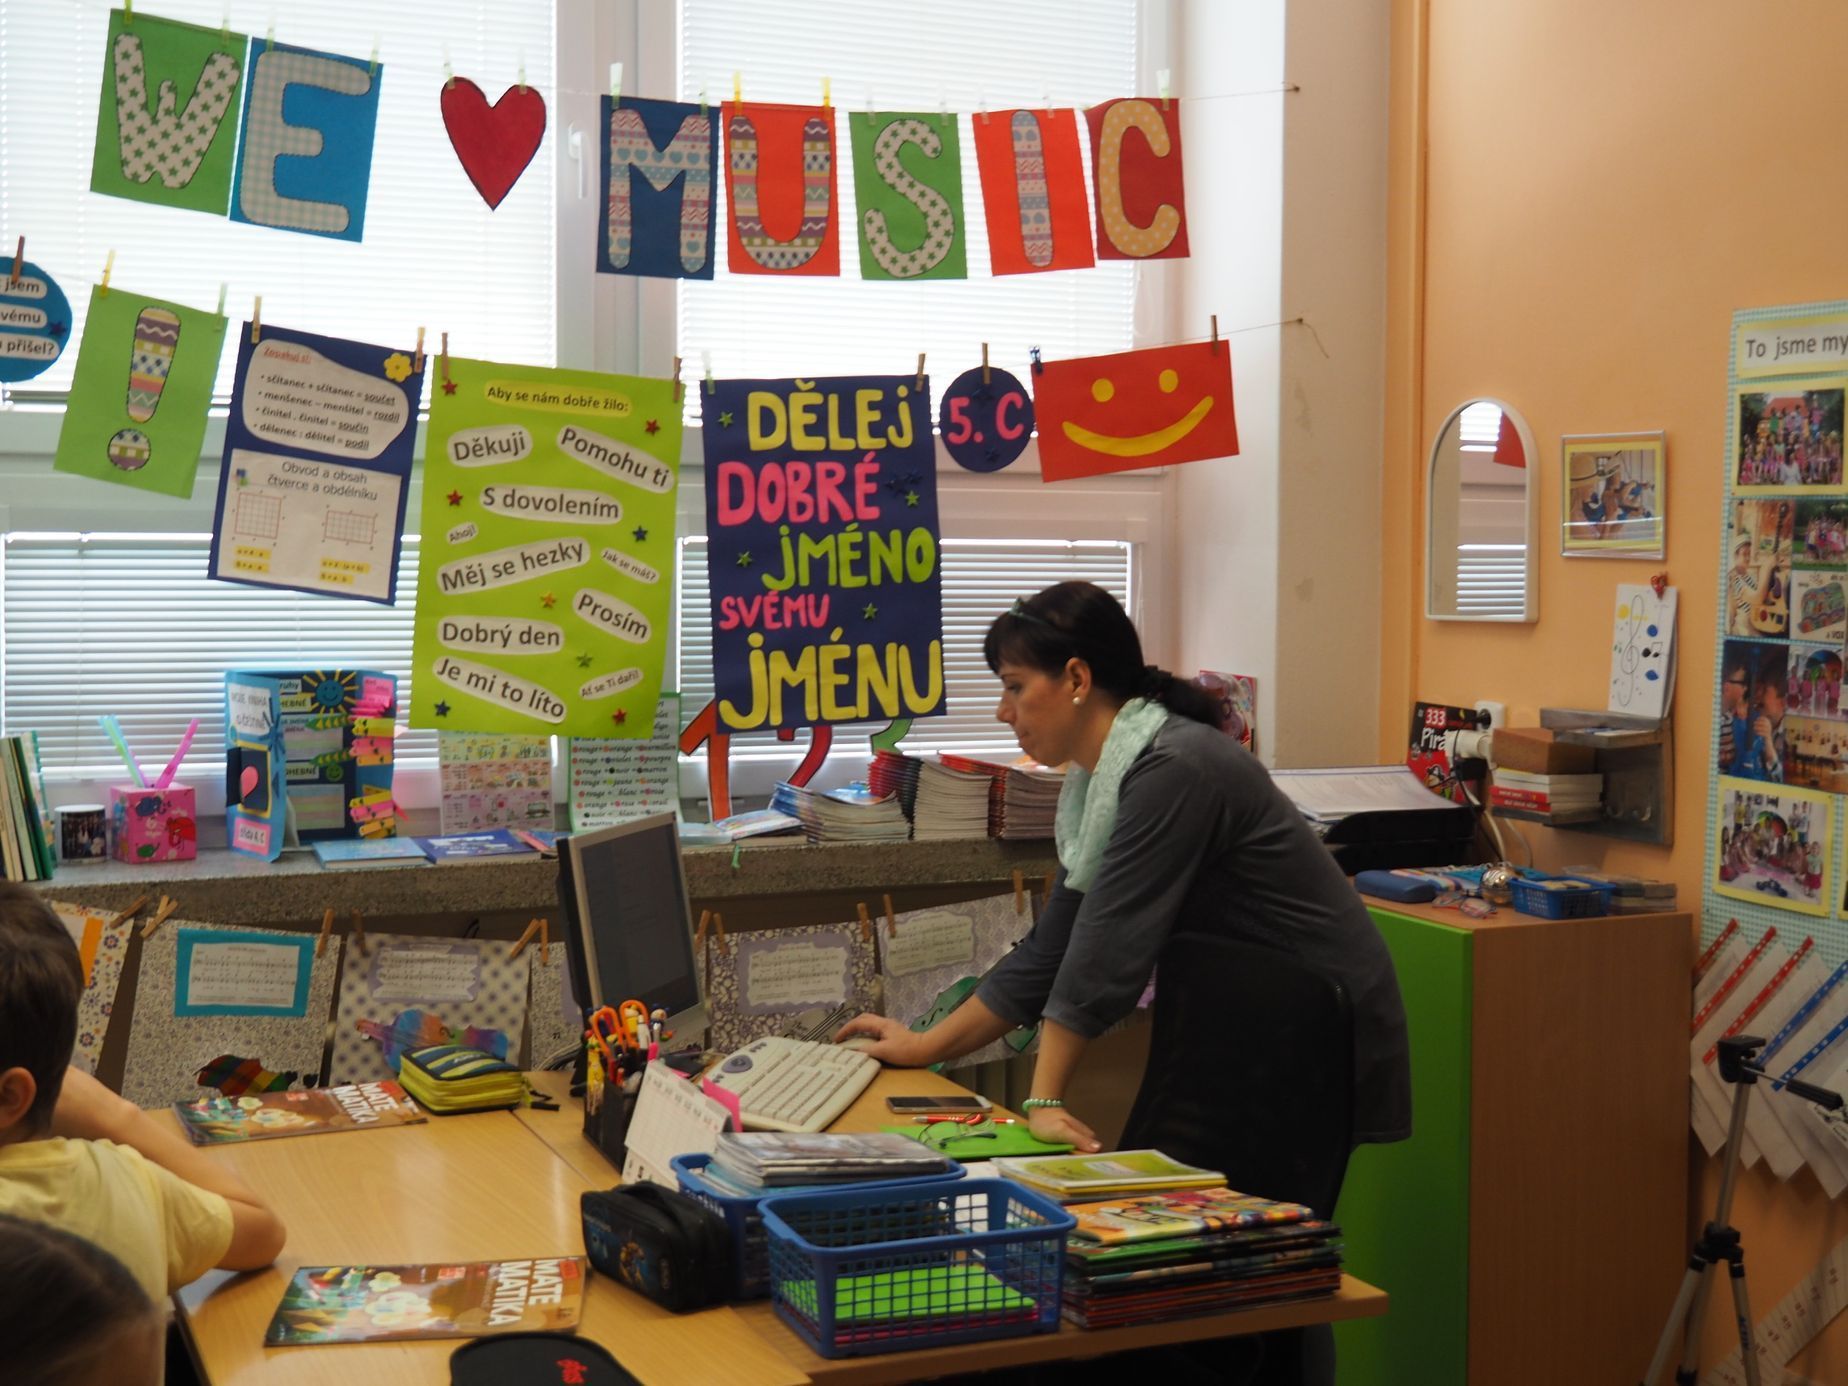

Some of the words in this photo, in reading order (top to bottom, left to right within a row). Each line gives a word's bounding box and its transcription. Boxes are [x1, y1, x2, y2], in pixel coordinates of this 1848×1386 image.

[113, 32, 372, 234] WE
[607, 99, 1180, 278] MUSIC
[0, 308, 41, 324] vému
[6, 340, 56, 356] přišel?
[1746, 338, 1767, 358] To
[1774, 336, 1817, 361] jsme
[1822, 333, 1848, 356] my
[264, 390, 313, 407] menšenec
[323, 401, 364, 417] menšitel
[266, 374, 306, 390] sčítanec
[316, 382, 355, 399] sčítanec
[364, 391, 396, 407] součet
[487, 386, 512, 402] Aby
[516, 392, 529, 401] se
[532, 392, 559, 405] nám
[563, 393, 600, 409] dobře
[602, 397, 629, 412] žilo:
[262, 407, 292, 421] činitel
[299, 412, 328, 426] činitel
[338, 420, 369, 434] součin
[947, 396, 984, 445] 5.
[995, 391, 1025, 440] C
[260, 423, 297, 438] dělenec
[305, 429, 335, 444] dělitel
[345, 438, 369, 450] podíl
[453, 431, 526, 461] Děkuji
[281, 460, 319, 478] Obvod
[322, 470, 330, 479] a
[333, 470, 368, 485] obsah
[560, 427, 648, 479] Pomohu
[652, 466, 668, 487] ti
[267, 473, 309, 491] čtverce
[312, 484, 320, 492] a
[323, 483, 378, 501] obdélníku
[483, 486, 496, 506] S
[503, 488, 619, 518] dovolením
[717, 451, 881, 526] DOBRÉ
[441, 565, 486, 591] Měj
[492, 560, 516, 579] se
[520, 542, 584, 571] hezky
[602, 550, 618, 564] Jak
[618, 557, 630, 569] se
[578, 593, 649, 639] Prosím
[718, 589, 831, 630] SVÉMU
[442, 622, 513, 649] Dobrý
[519, 625, 560, 646] den
[437, 658, 461, 680] Je
[466, 674, 497, 694] mi
[501, 681, 523, 702] to
[528, 691, 564, 719] líto
[1425, 707, 1446, 726] 333
[331, 1084, 380, 1124] MATIKA
[358, 1081, 400, 1112] MATE
[488, 1260, 533, 1326] MATIKA
[528, 1259, 564, 1306] MATE
